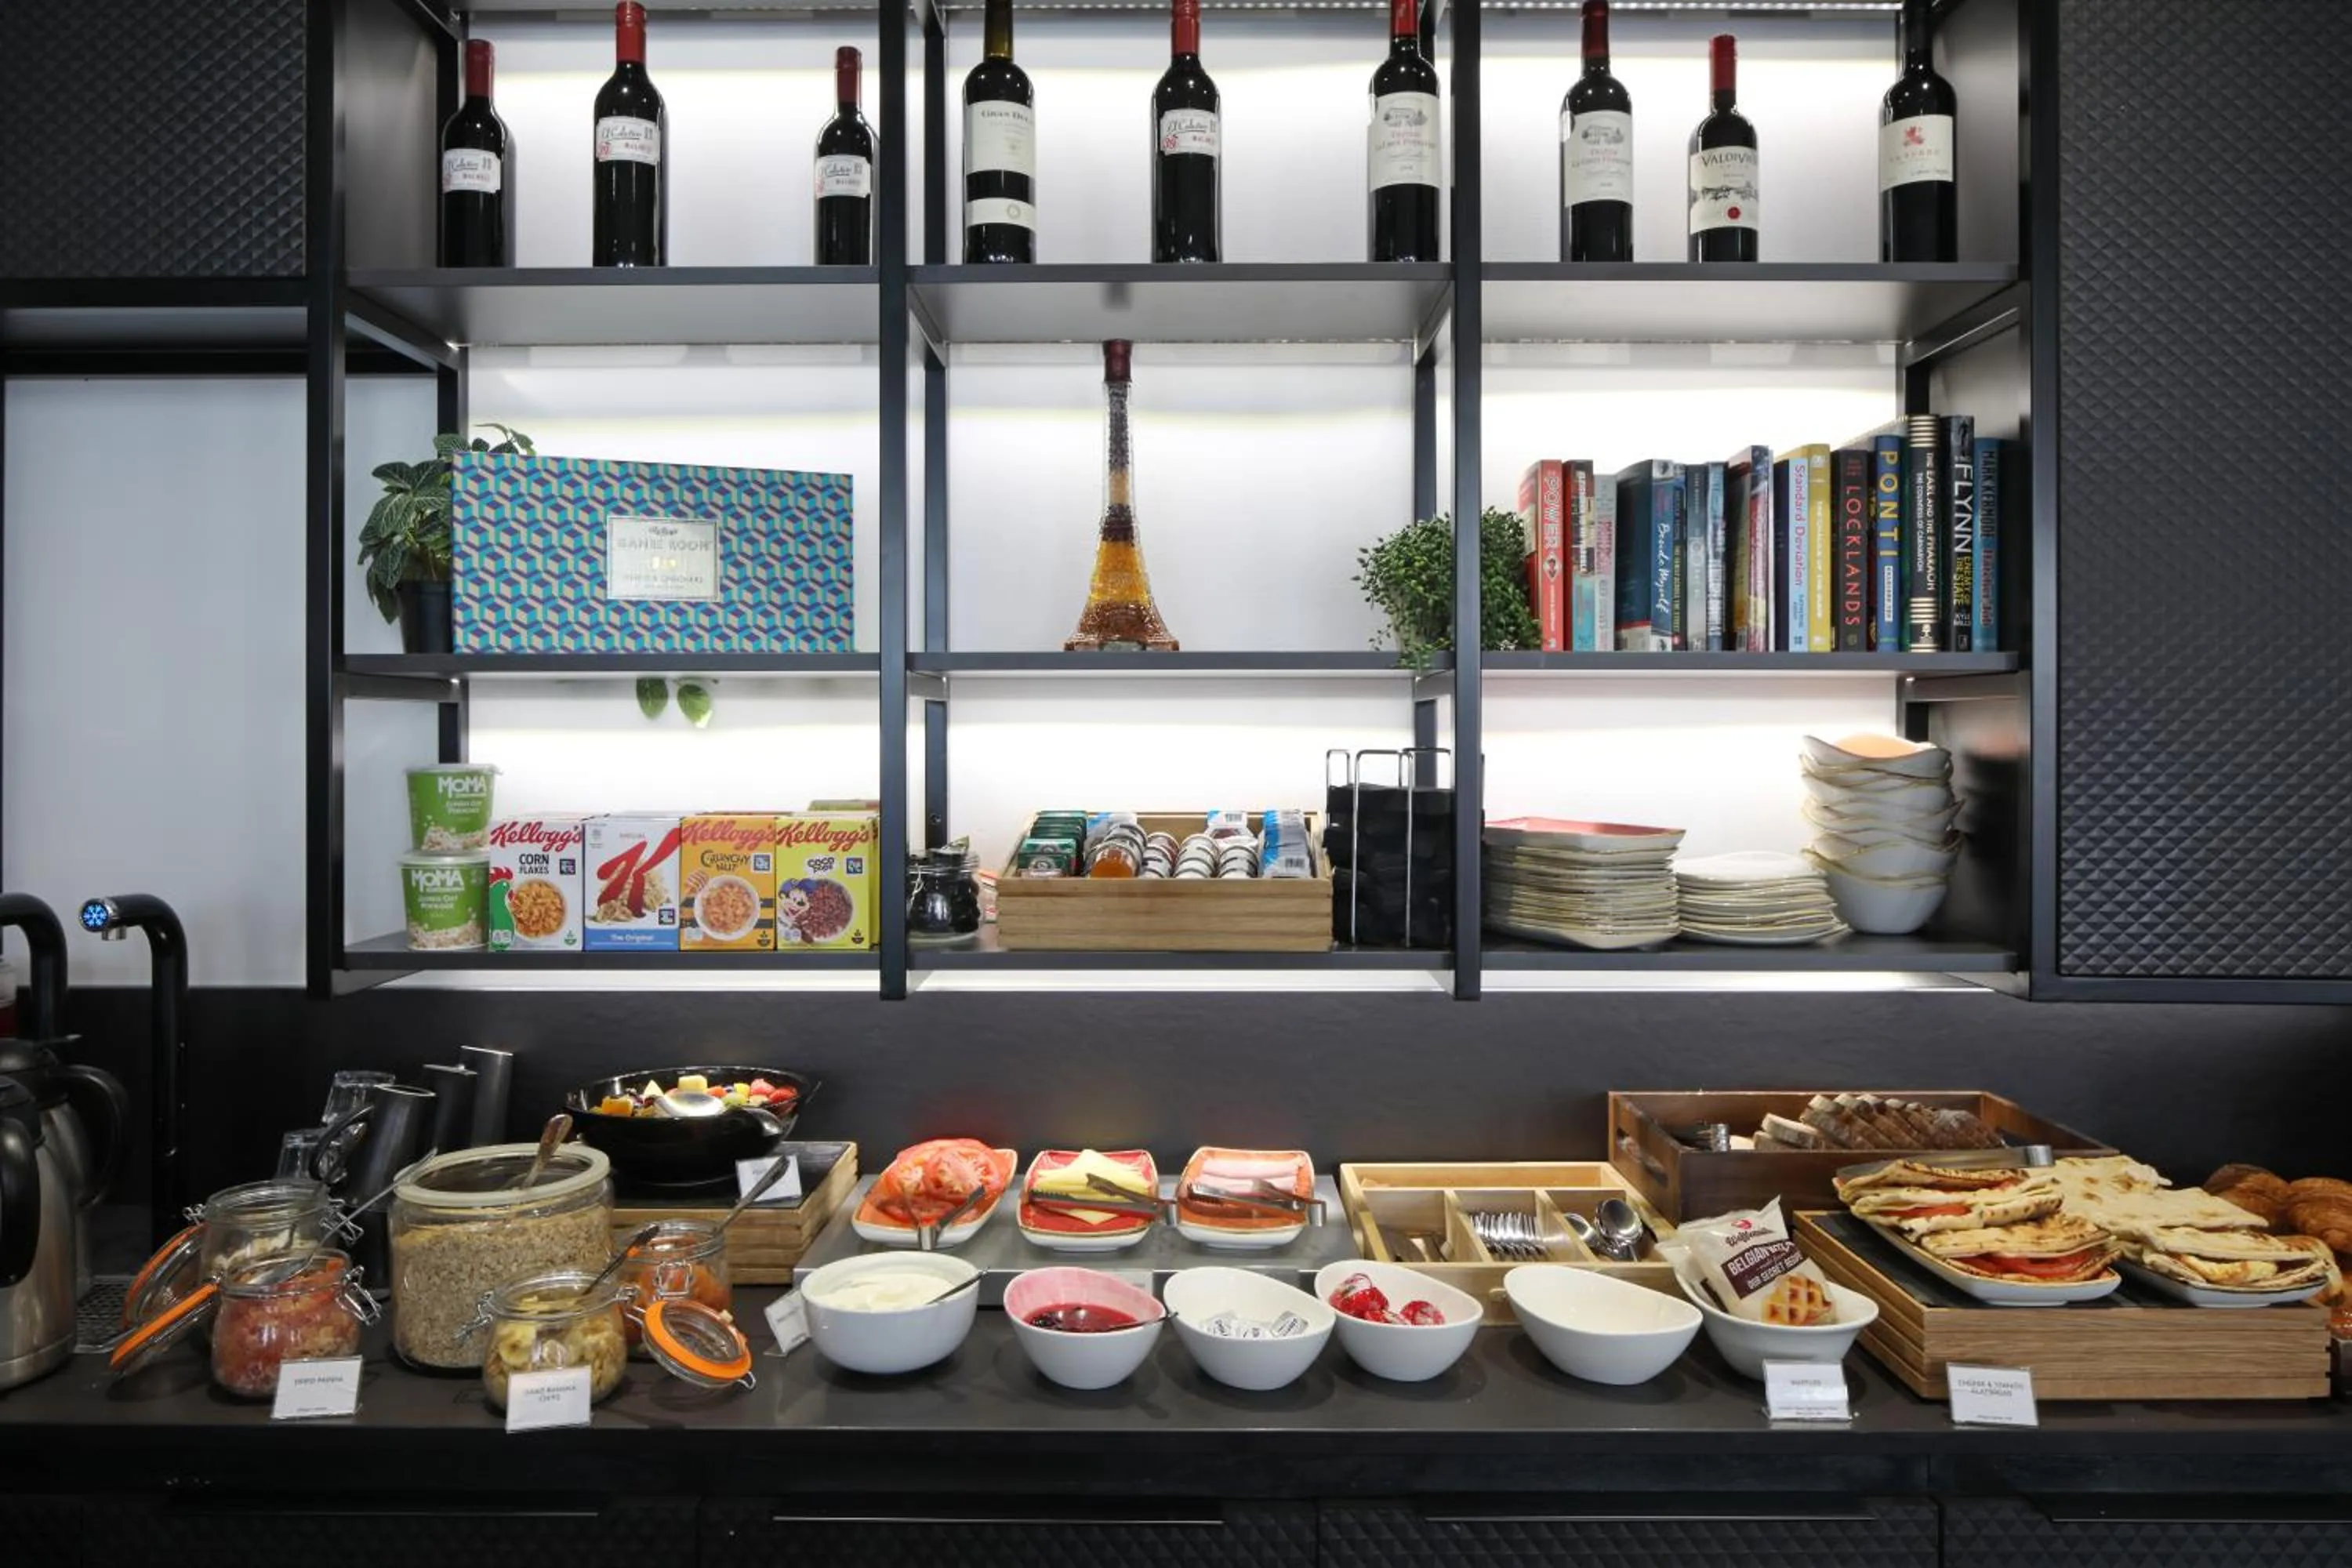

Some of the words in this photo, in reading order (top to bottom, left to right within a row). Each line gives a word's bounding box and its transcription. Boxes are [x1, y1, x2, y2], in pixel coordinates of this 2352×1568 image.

[1981, 451, 1997, 481] MARK
[1794, 464, 1806, 522] Standard
[1926, 470, 1936, 495] EARL
[1544, 476, 1559, 549] POWER
[1879, 451, 1898, 557] PONTI
[1954, 463, 1973, 553] FLYNN
[1795, 525, 1806, 586] Deviation
[1846, 485, 1862, 626] LOCKLANDS
[1926, 535, 1936, 590] PHARAOH
[437, 775, 487, 798] MOMA
[490, 821, 582, 852] Kellogg's
[681, 819, 775, 851] Kellogg's
[775, 821, 869, 852] Kellogg's
[519, 853, 550, 864] CORN
[519, 864, 550, 874] FLAKES
[700, 849, 750, 867] CRUNCHY
[716, 862, 738, 871] NUT
[411, 869, 465, 892] MOMA
[1727, 1247, 1769, 1276] BELGIAN
